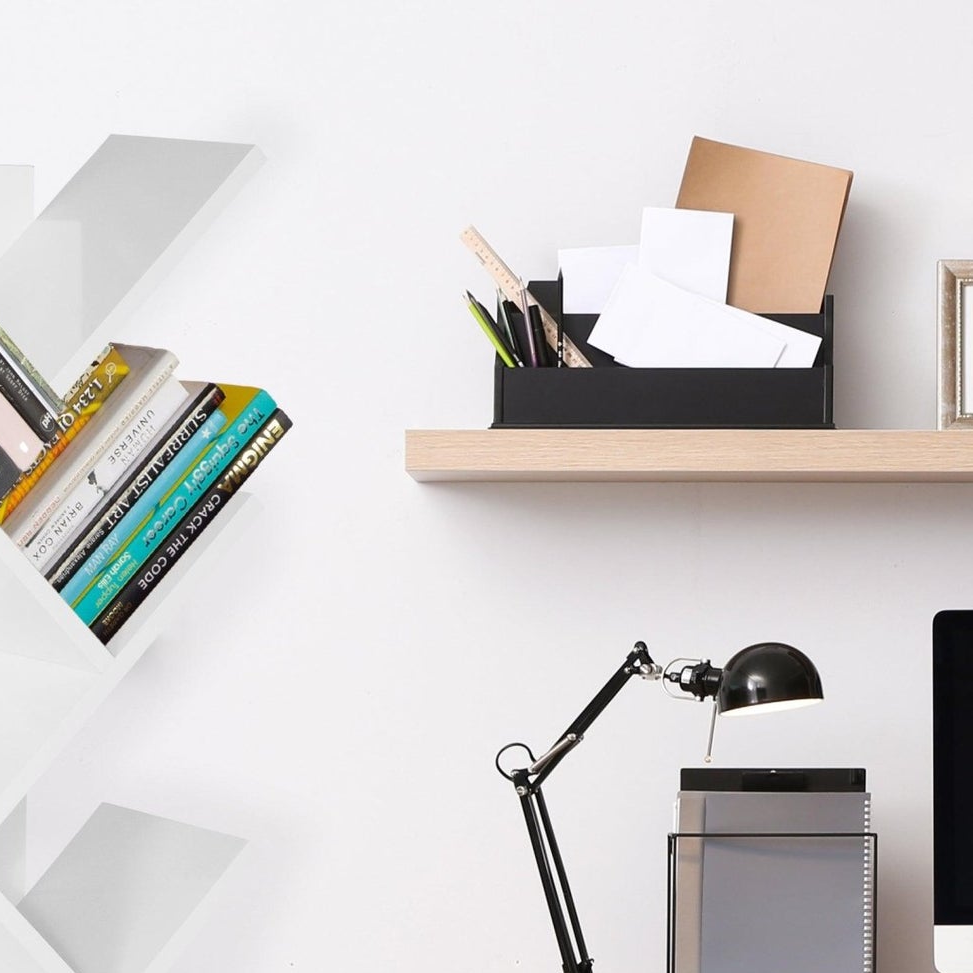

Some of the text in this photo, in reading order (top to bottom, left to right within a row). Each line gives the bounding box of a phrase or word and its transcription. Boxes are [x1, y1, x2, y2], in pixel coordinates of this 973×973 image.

[69, 376, 104, 414] 1,234
[106, 408, 155, 465] UNIVERSE
[119, 423, 156, 465] HUMAN
[100, 406, 209, 530] SURREALIST ART
[139, 405, 265, 550] The Squiggly Career
[53, 501, 84, 536] BRIAN
[136, 417, 287, 591] ENIGMA CRACK THE CODE
[31, 536, 55, 561] COX
[82, 532, 122, 576] MAN RAY
[96, 550, 132, 590] Sarah Ellis
[91, 557, 138, 609] Helen Tupper
